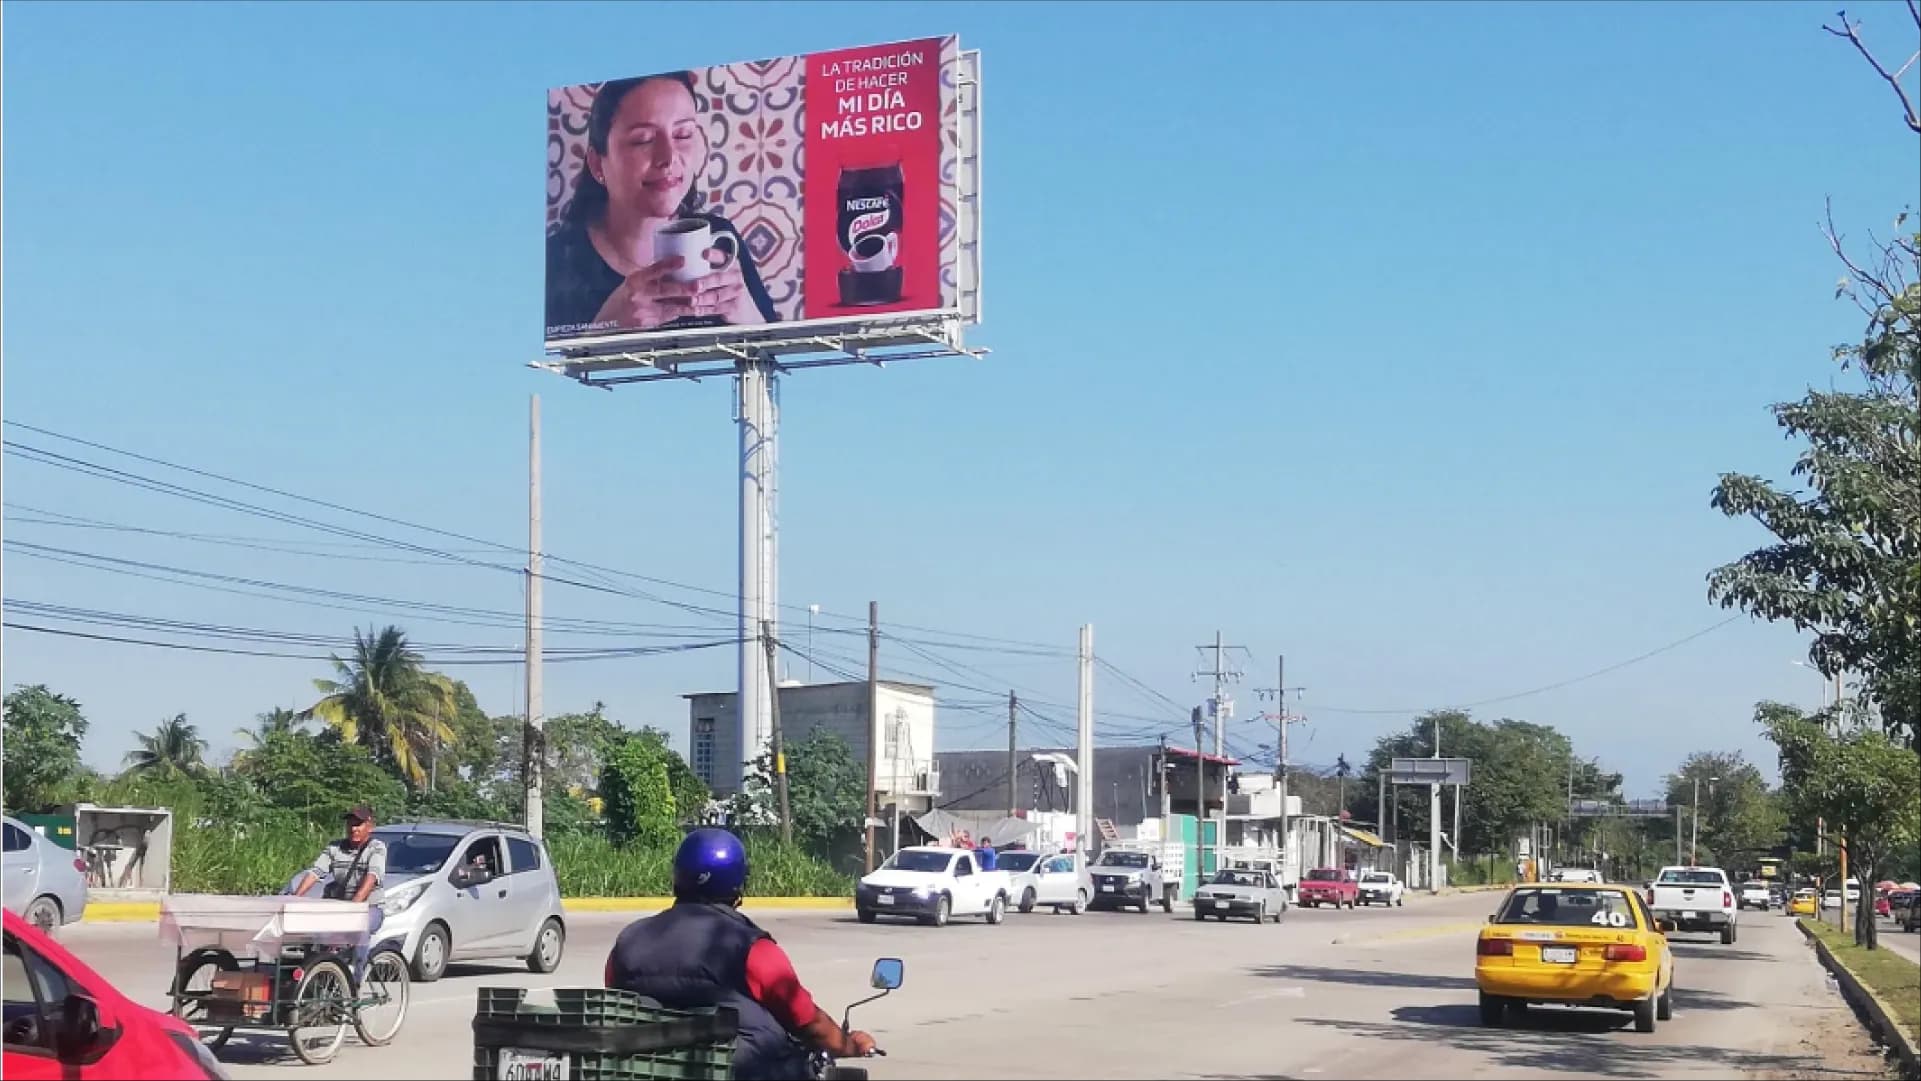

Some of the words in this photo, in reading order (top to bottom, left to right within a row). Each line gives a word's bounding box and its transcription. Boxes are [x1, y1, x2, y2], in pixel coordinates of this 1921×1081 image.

[822, 62, 840, 77] LA
[842, 50, 923, 73] TRADICIÓN
[835, 78, 856, 93] DE
[858, 72, 907, 89] HACER
[838, 95, 862, 114] MI
[868, 88, 905, 111] DÍA
[821, 115, 867, 139] MÁS
[871, 111, 922, 134] RICO
[1591, 910, 1626, 927] 40
